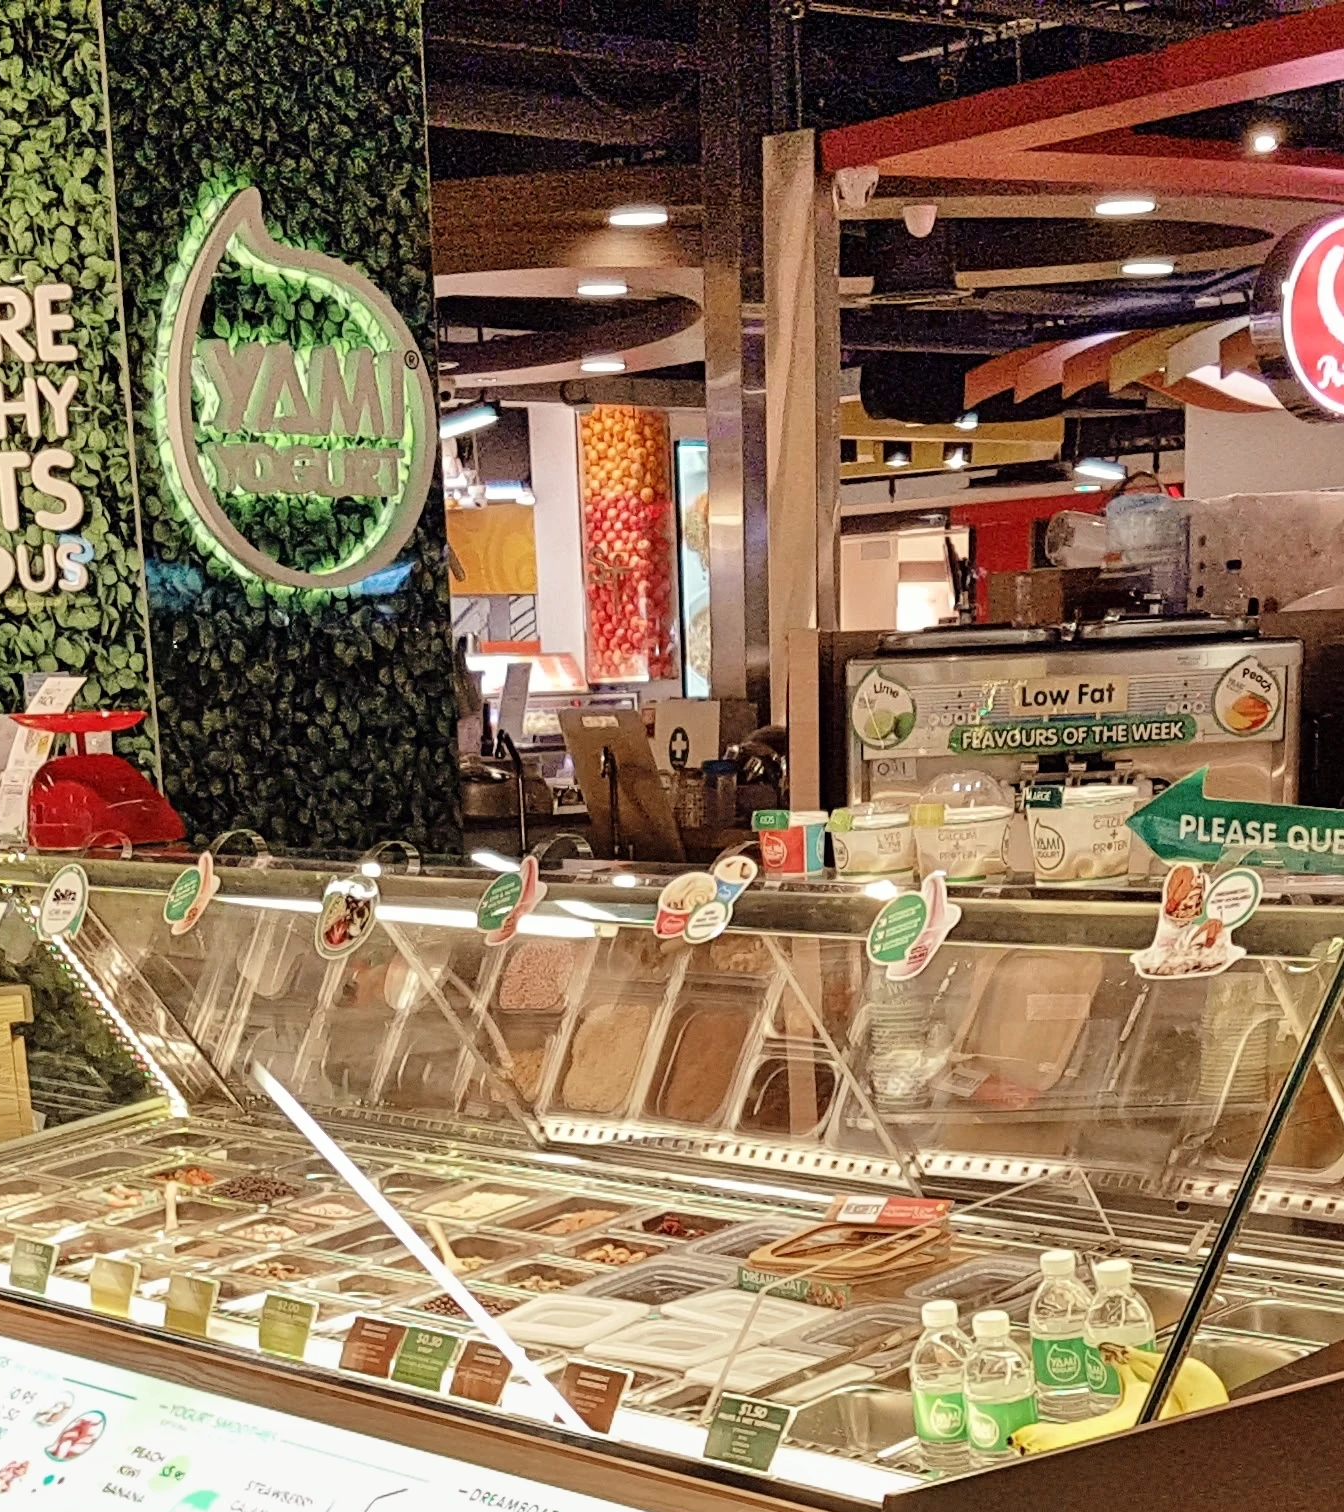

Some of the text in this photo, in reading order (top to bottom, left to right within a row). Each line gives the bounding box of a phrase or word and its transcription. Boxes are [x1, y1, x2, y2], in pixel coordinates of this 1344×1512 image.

[198, 337, 406, 440] YAMI
[205, 445, 406, 498] YOGURT
[873, 682, 900, 700] Lime
[1242, 666, 1273, 694] Peach
[1021, 682, 1116, 709] Low Fat
[960, 720, 1184, 752] FLAVOURS OF THE WEEK
[1036, 837, 1061, 850] YAMI
[1178, 813, 1279, 849] PLEASE
